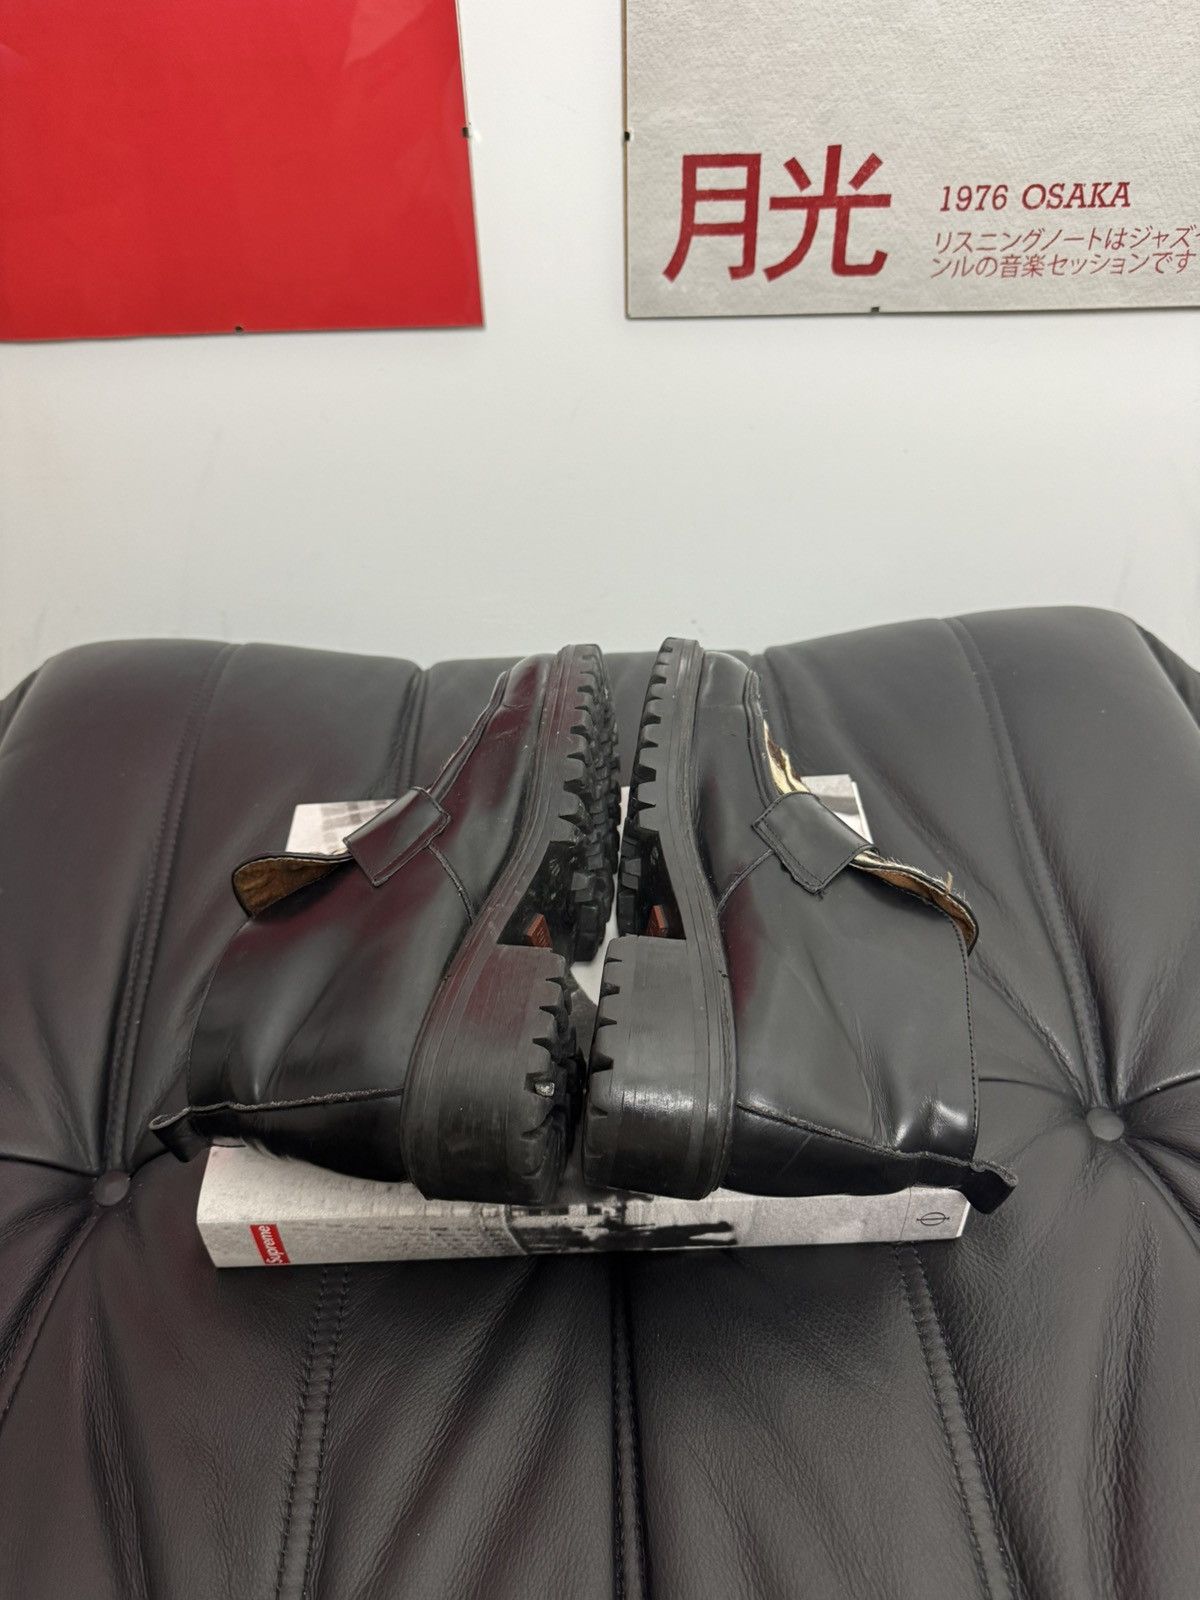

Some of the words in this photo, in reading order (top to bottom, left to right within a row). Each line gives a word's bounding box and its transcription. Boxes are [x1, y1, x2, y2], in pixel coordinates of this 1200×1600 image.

[940, 184, 1009, 212] 1976
[1021, 181, 1131, 210] OSAKA
[661, 144, 893, 284] 月光
[935, 224, 1200, 254] リスニングノートはジャズ
[931, 249, 1197, 278] ンルの音楽セッションです
[258, 1225, 284, 1264] Supreme
